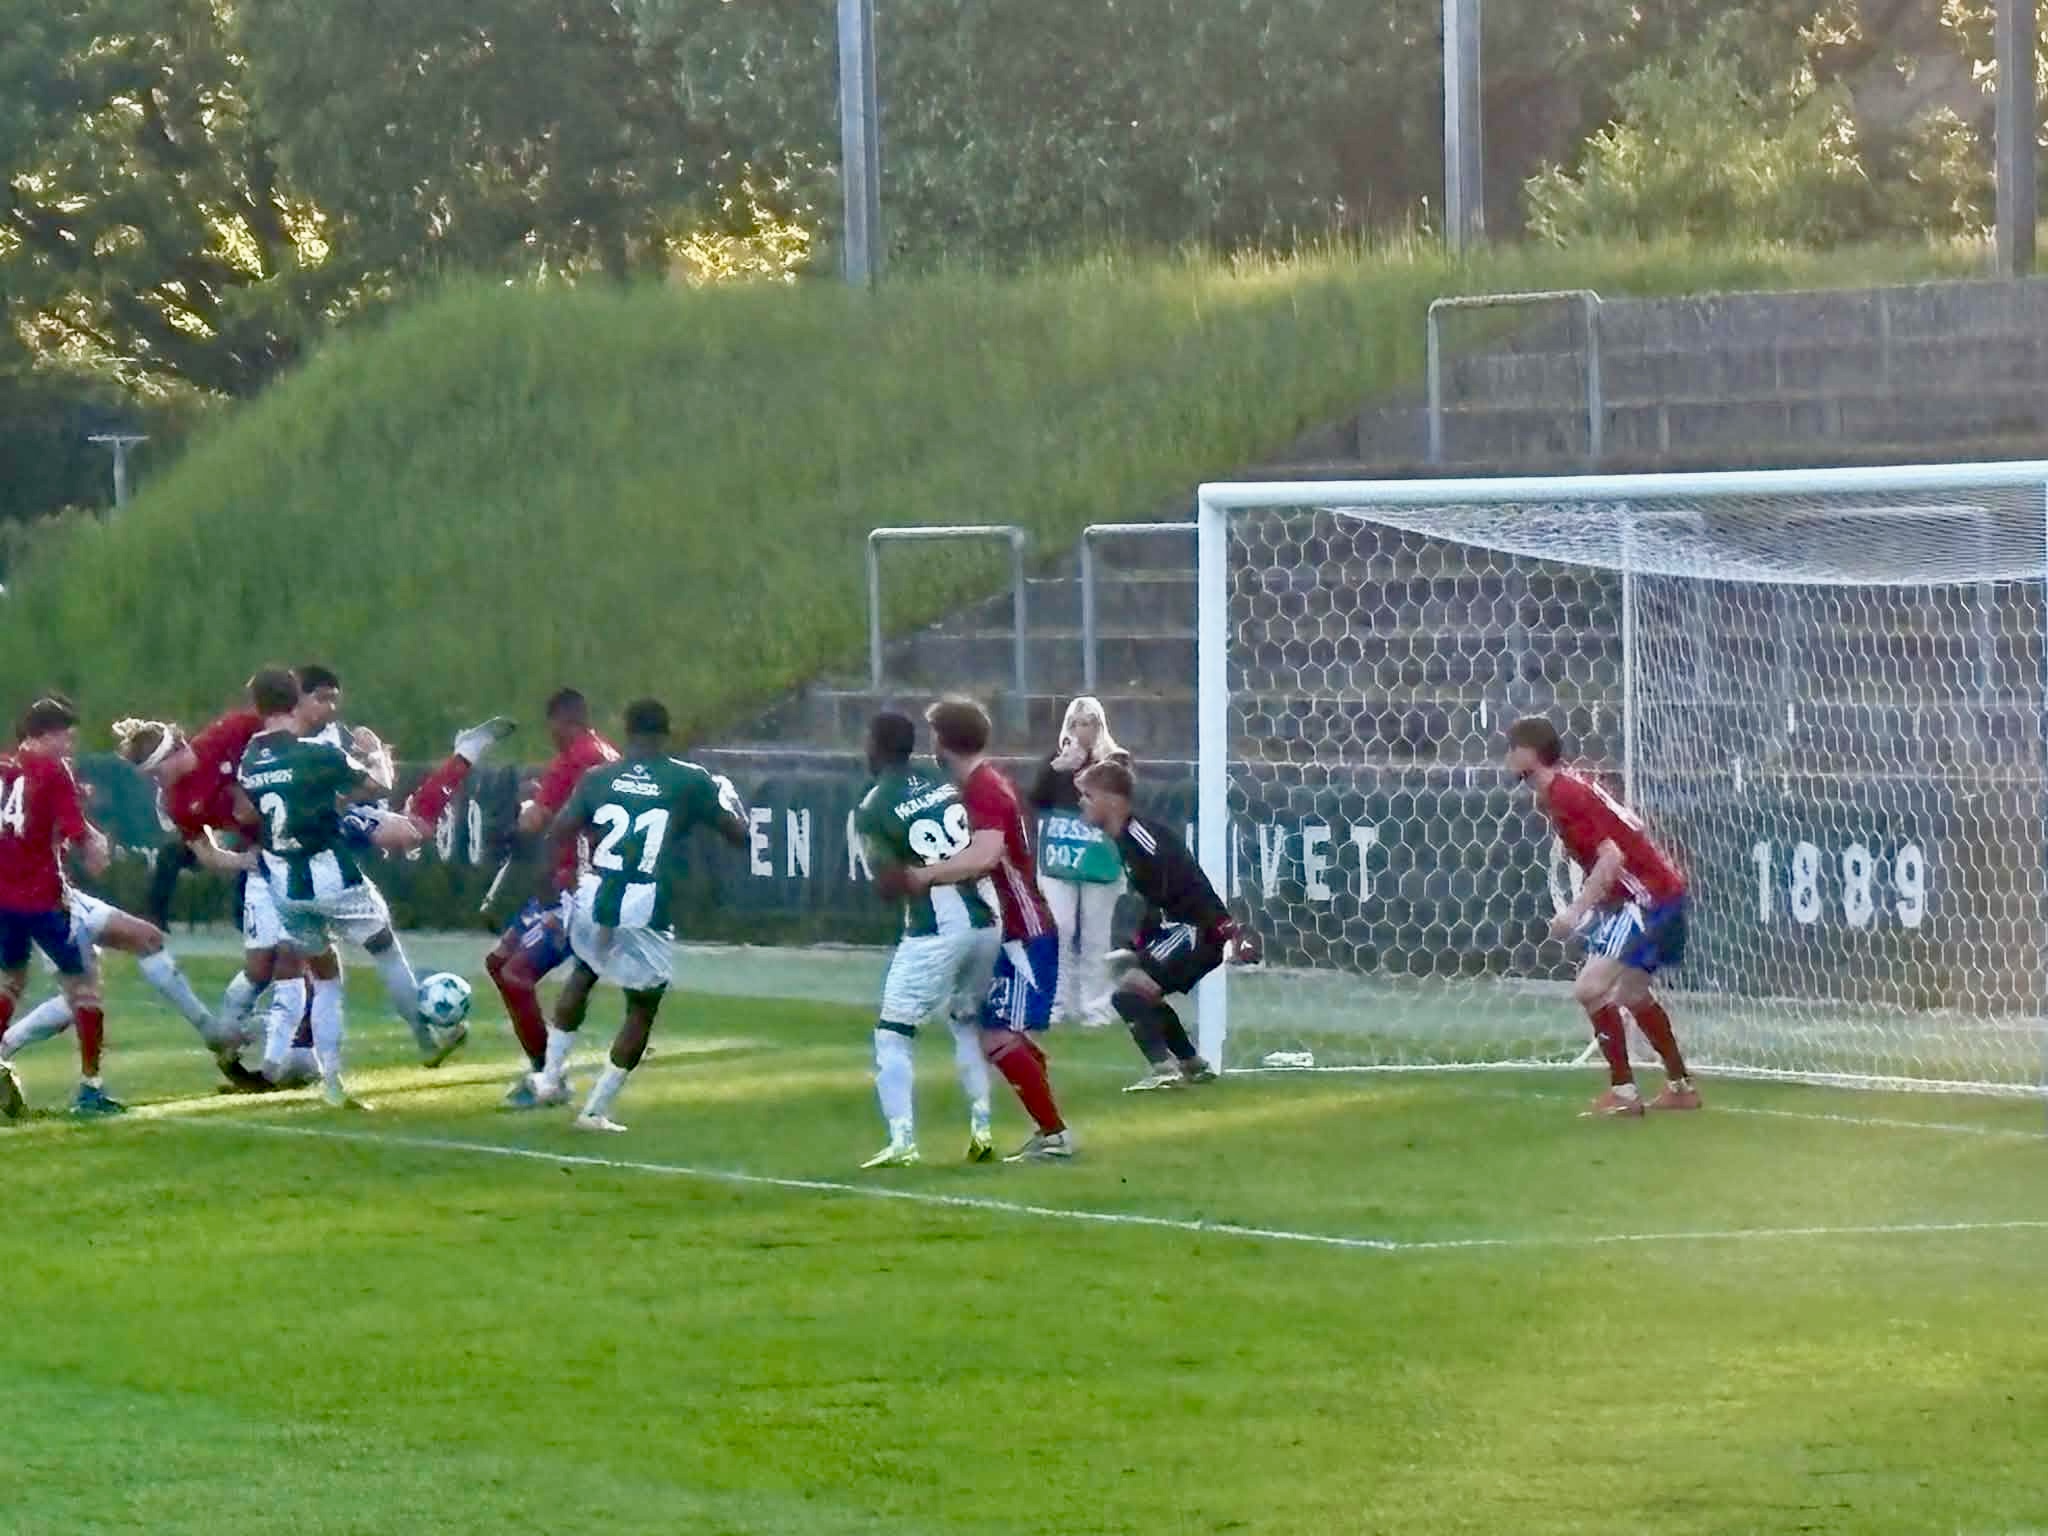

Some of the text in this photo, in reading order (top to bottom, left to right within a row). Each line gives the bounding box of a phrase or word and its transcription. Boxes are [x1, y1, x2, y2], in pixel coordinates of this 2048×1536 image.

[259, 792, 302, 850] 2
[592, 803, 669, 874] 21
[1752, 841, 1924, 928] 1889
